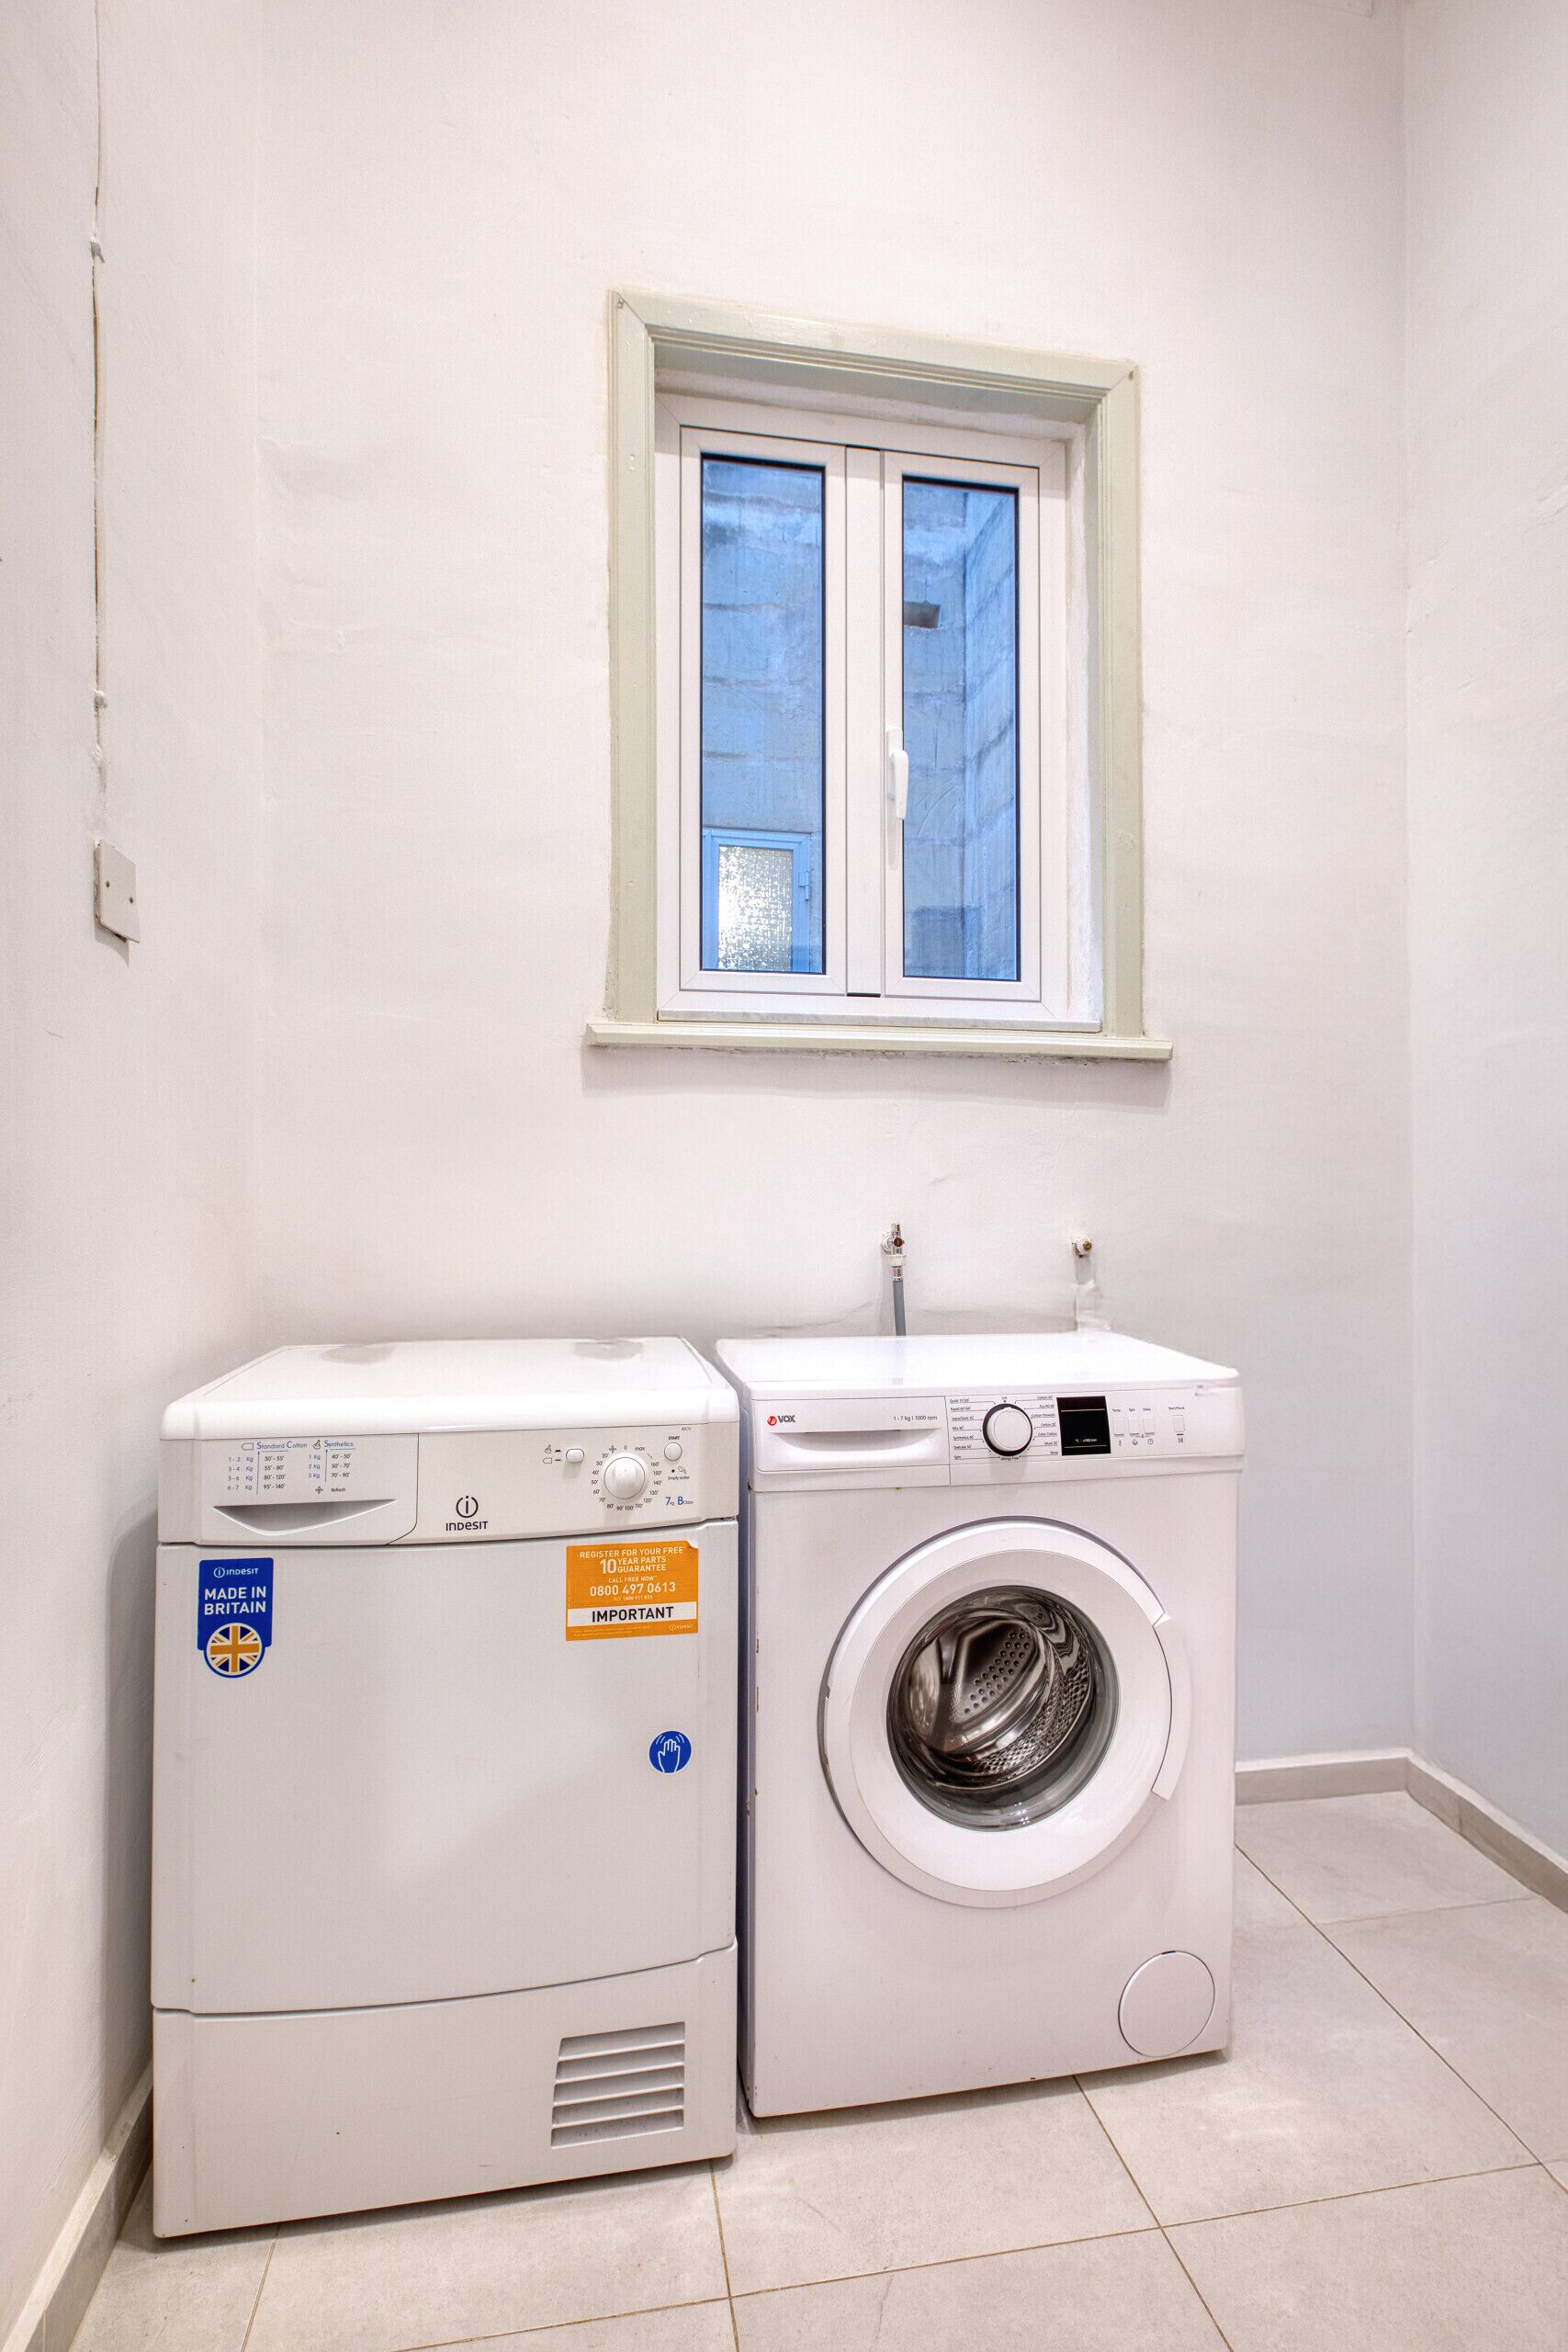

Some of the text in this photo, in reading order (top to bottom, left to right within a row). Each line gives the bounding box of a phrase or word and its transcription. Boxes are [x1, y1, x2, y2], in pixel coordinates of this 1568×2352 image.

[777, 1415, 796, 1423] VOX
[257, 1441, 308, 1450] Standard Cotton
[323, 1440, 354, 1449] Synthetics
[580, 1550, 620, 1559] REGISTER
[622, 1548, 637, 1557] FOR
[639, 1547, 661, 1555] YOUR
[599, 1558, 617, 1575] 10
[617, 1555, 667, 1566] YEAR PARTS
[617, 1564, 667, 1574] GUARANTEE
[204, 1586, 266, 1600] MADE IN
[590, 1581, 676, 1597] 0800 497 0613
[204, 1600, 266, 1615] BRITAIN
[592, 1606, 674, 1623] IMPORTANT
